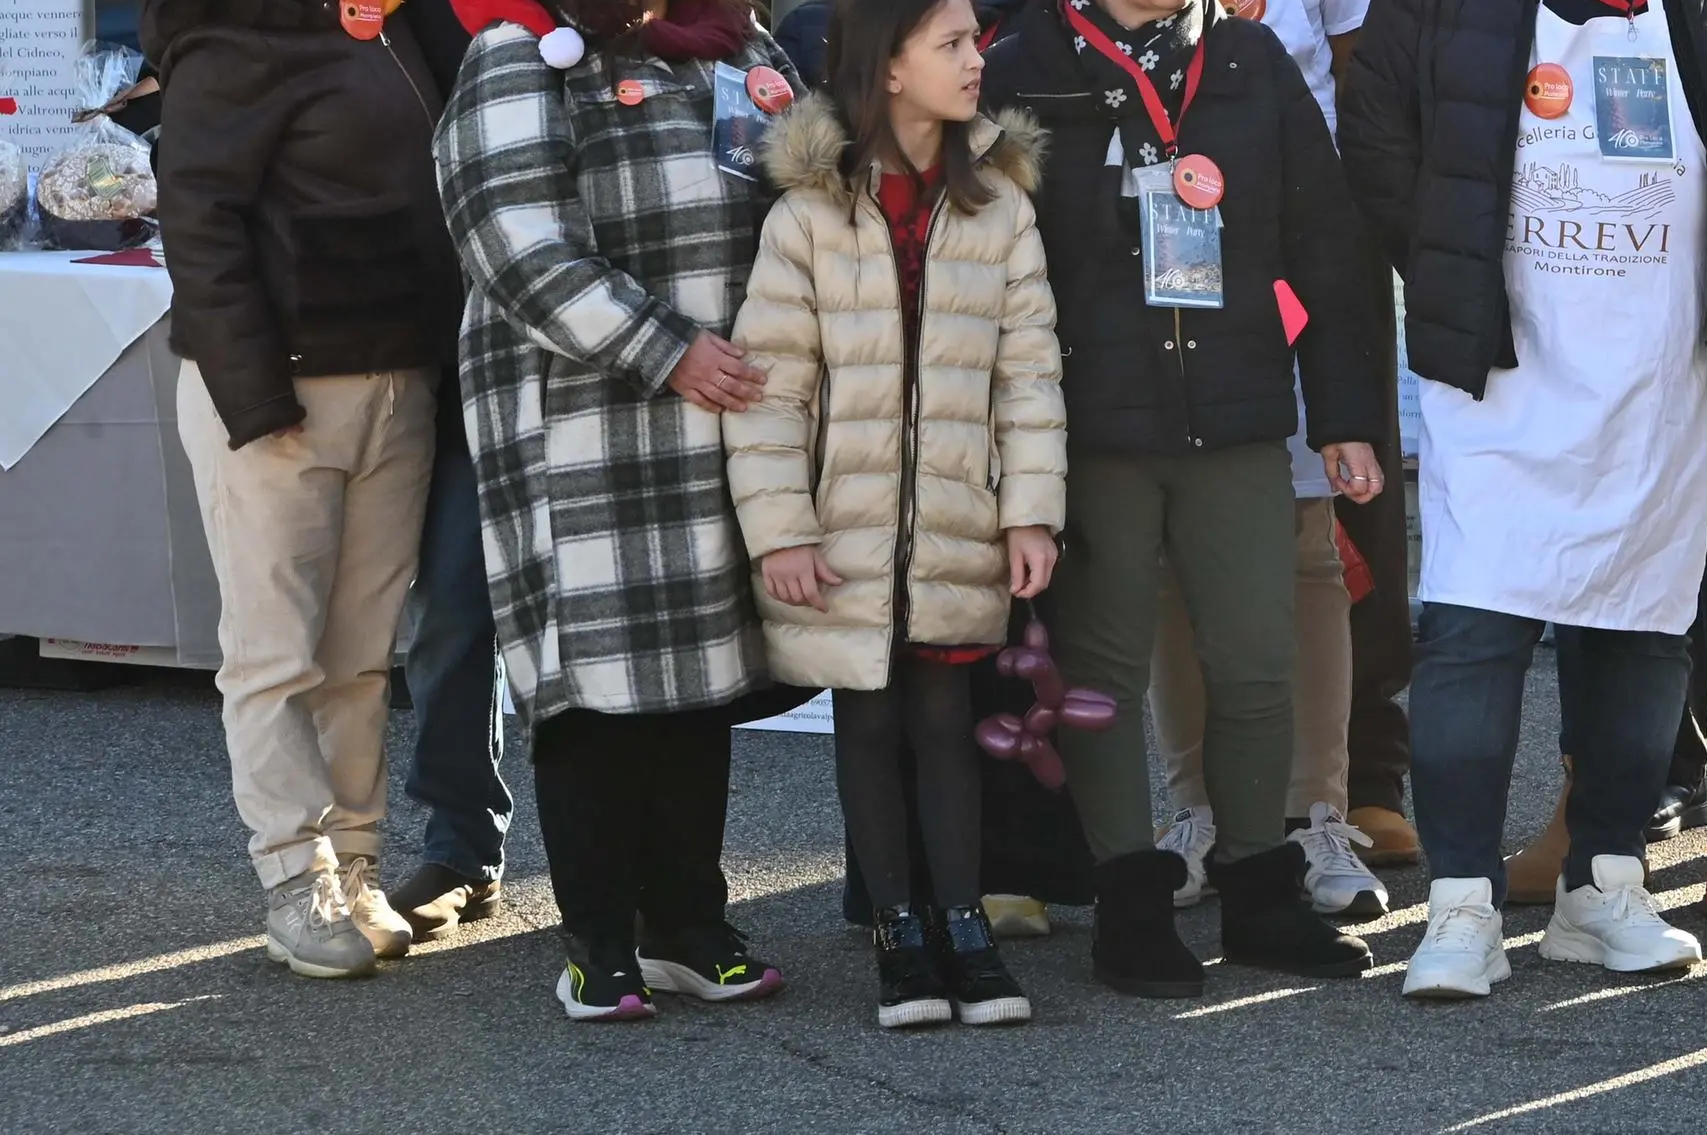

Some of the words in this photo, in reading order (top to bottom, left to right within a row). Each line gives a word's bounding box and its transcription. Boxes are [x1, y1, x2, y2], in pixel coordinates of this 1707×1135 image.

[1598, 67, 1664, 85] STAFF
[1517, 125, 1577, 149] celleria
[1547, 251, 1590, 262] DELLA
[1593, 253, 1668, 265] TRADIZIONE
[1534, 261, 1627, 278] Montirone
